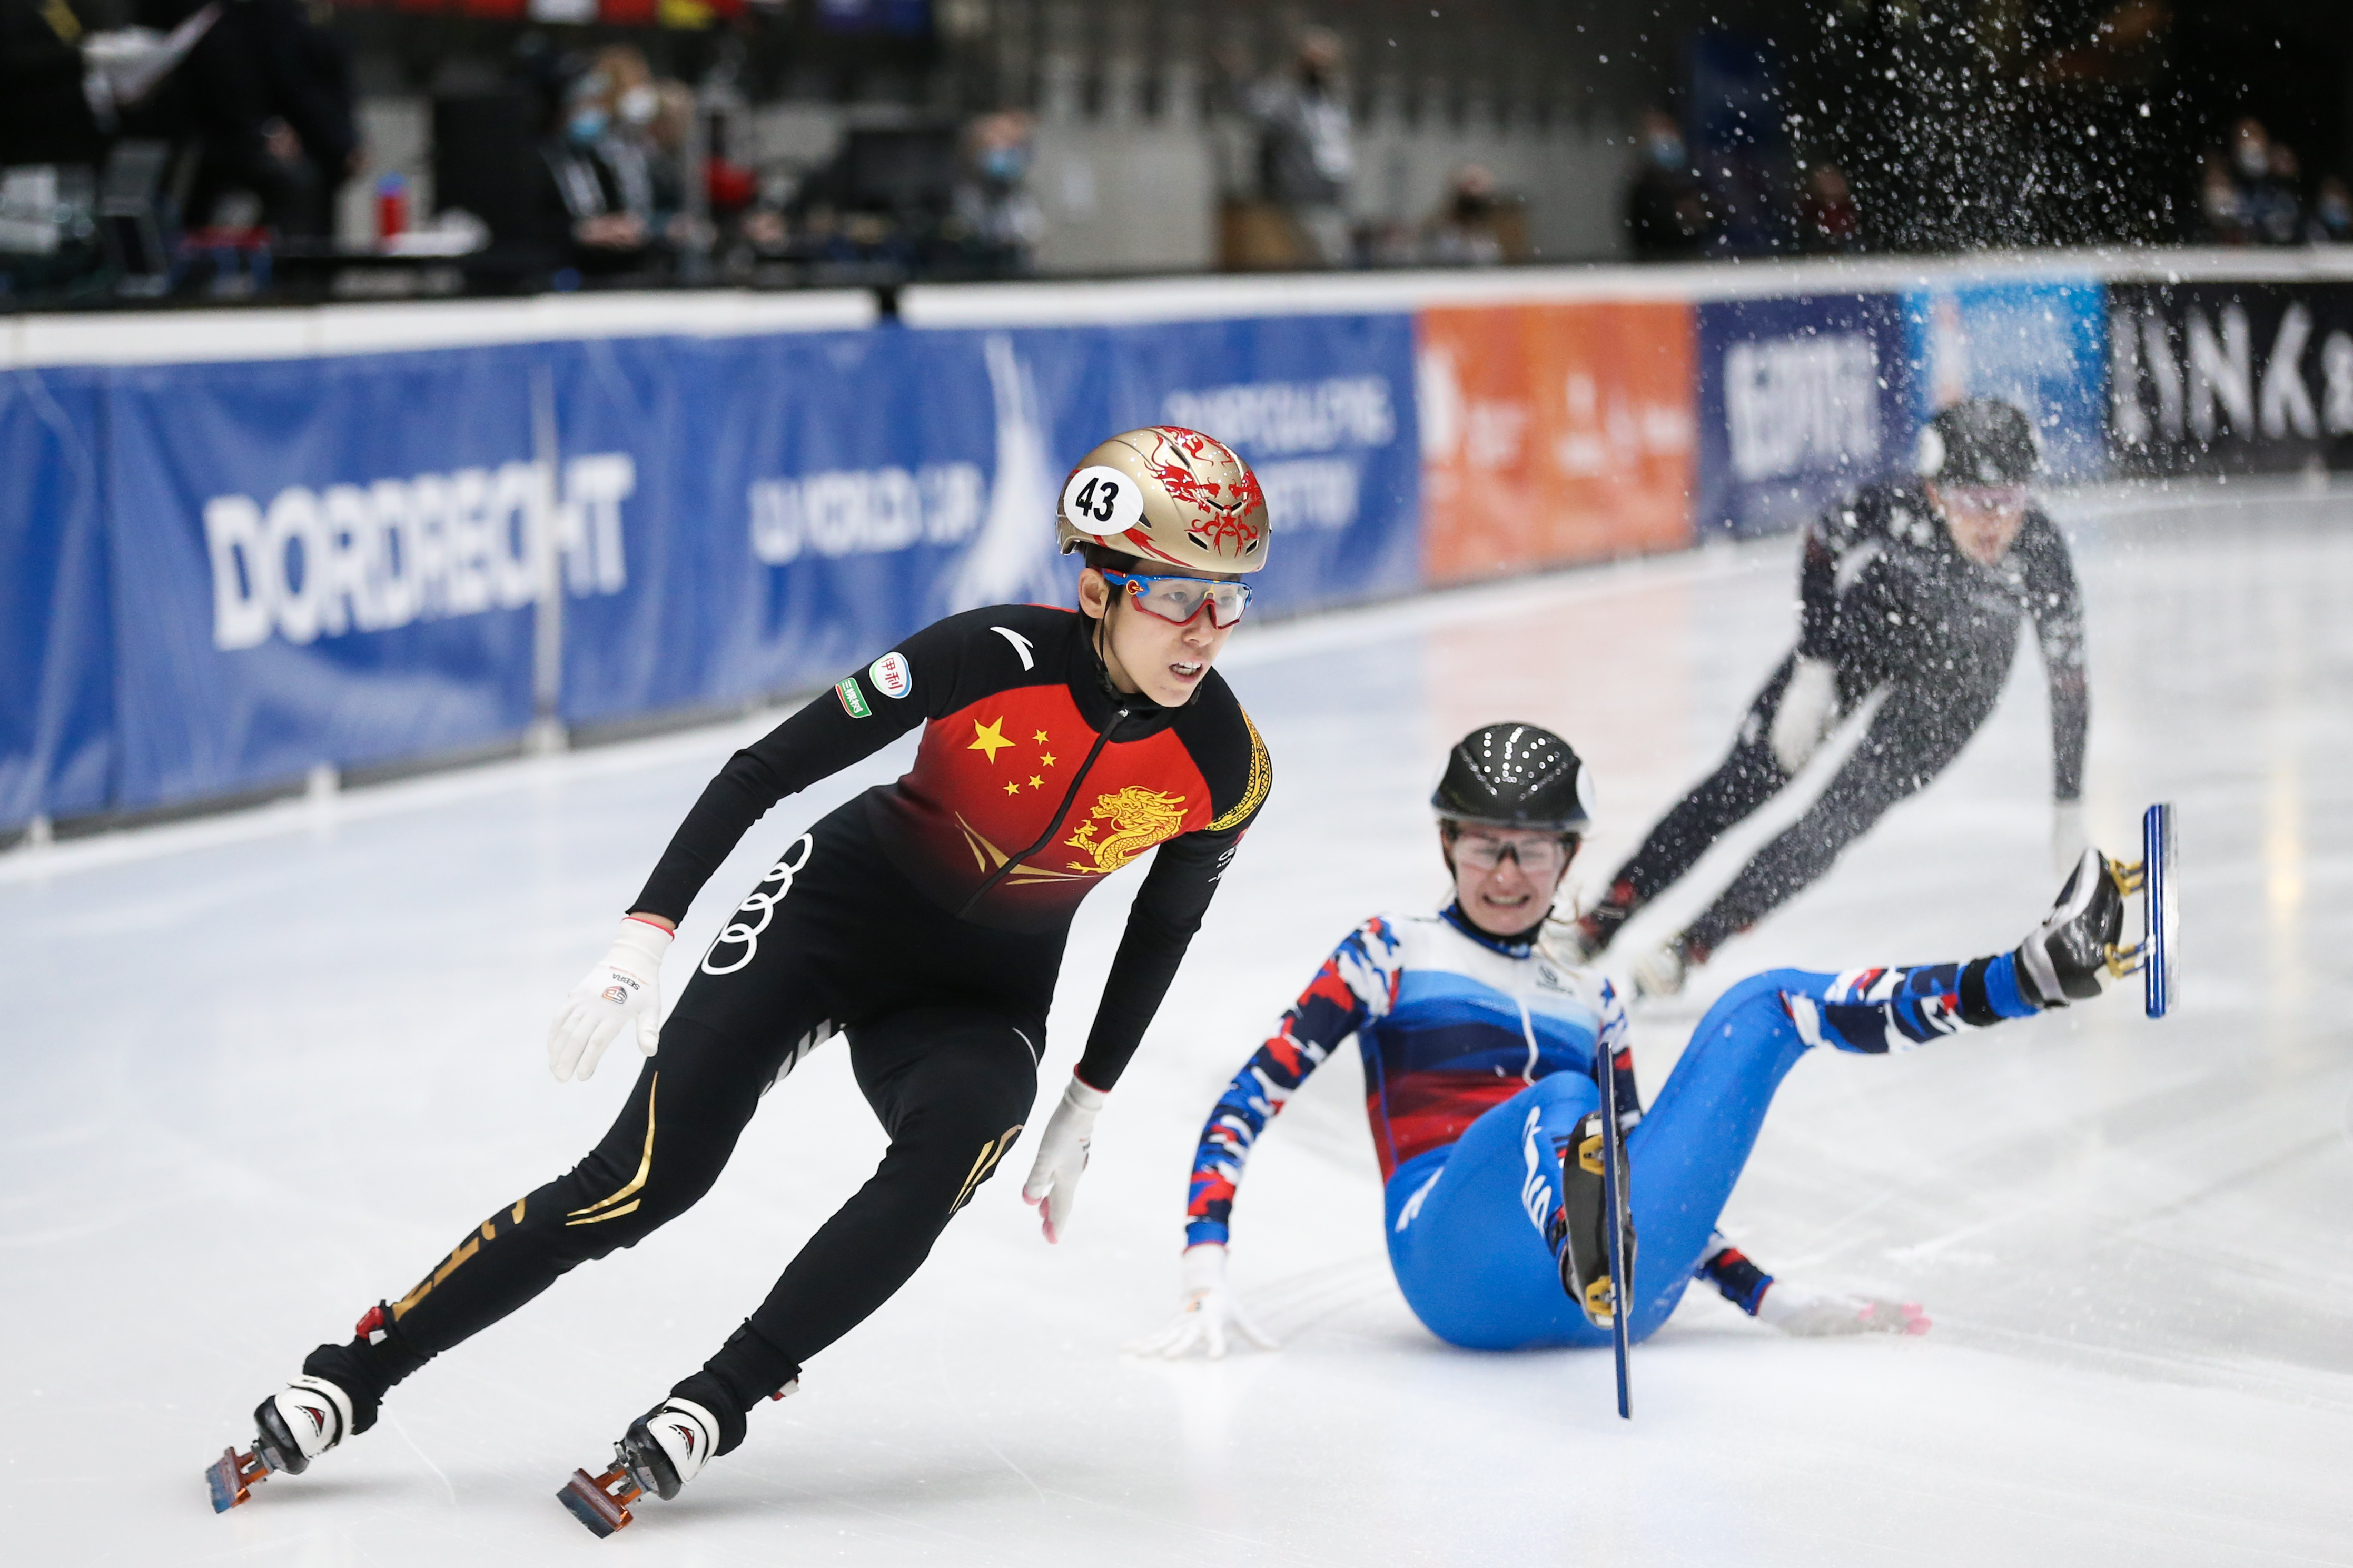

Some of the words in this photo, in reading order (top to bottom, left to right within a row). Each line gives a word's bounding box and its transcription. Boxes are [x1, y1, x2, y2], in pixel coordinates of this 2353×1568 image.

[1075, 477, 1119, 521] 43
[881, 657, 903, 689] 伊利
[842, 679, 864, 714] 三棵树
[612, 972, 640, 990] SEBRA
